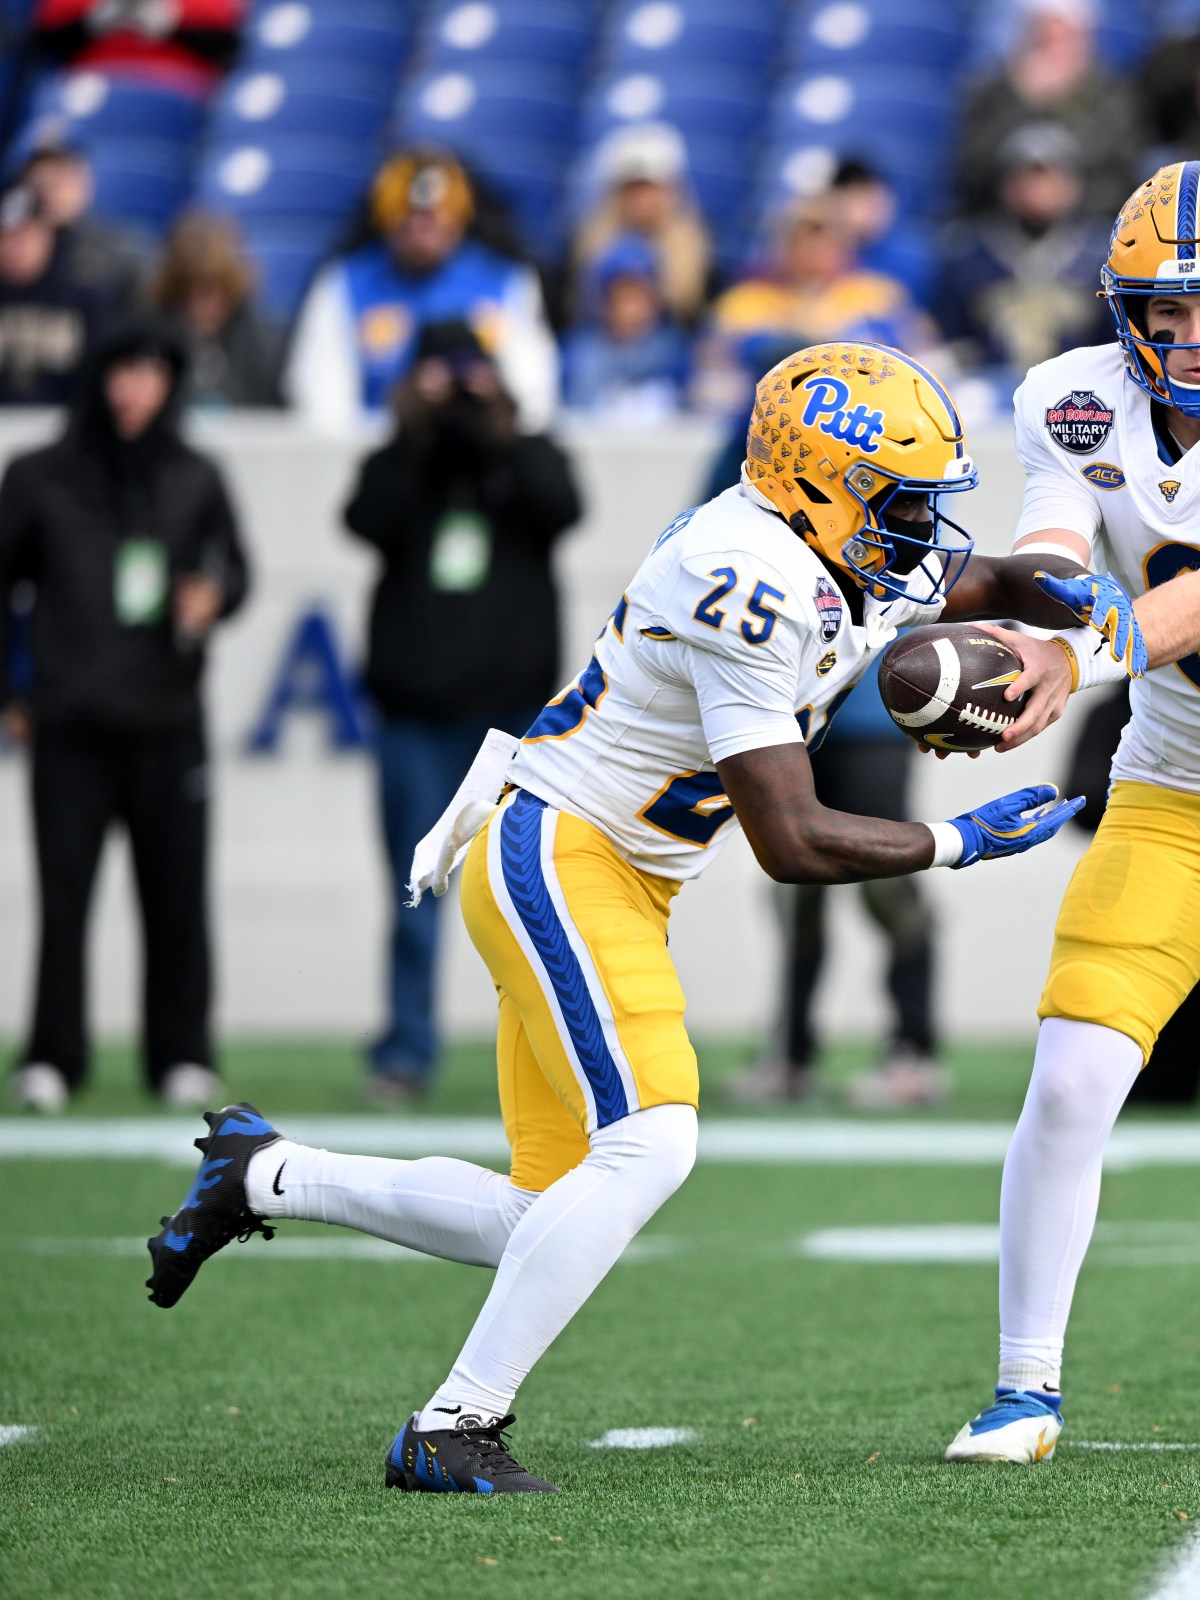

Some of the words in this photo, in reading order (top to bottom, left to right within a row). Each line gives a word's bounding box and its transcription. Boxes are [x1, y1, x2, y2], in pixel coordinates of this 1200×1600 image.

[1178, 262, 1196, 273] H2P
[801, 375, 886, 455] Pitt
[1047, 409, 1065, 423] GO
[1066, 409, 1112, 423] BOWLING
[1051, 423, 1108, 435] MILITARY
[1062, 434, 1097, 445] BOWL
[1087, 468, 1123, 483] ACC
[692, 565, 787, 647] 25
